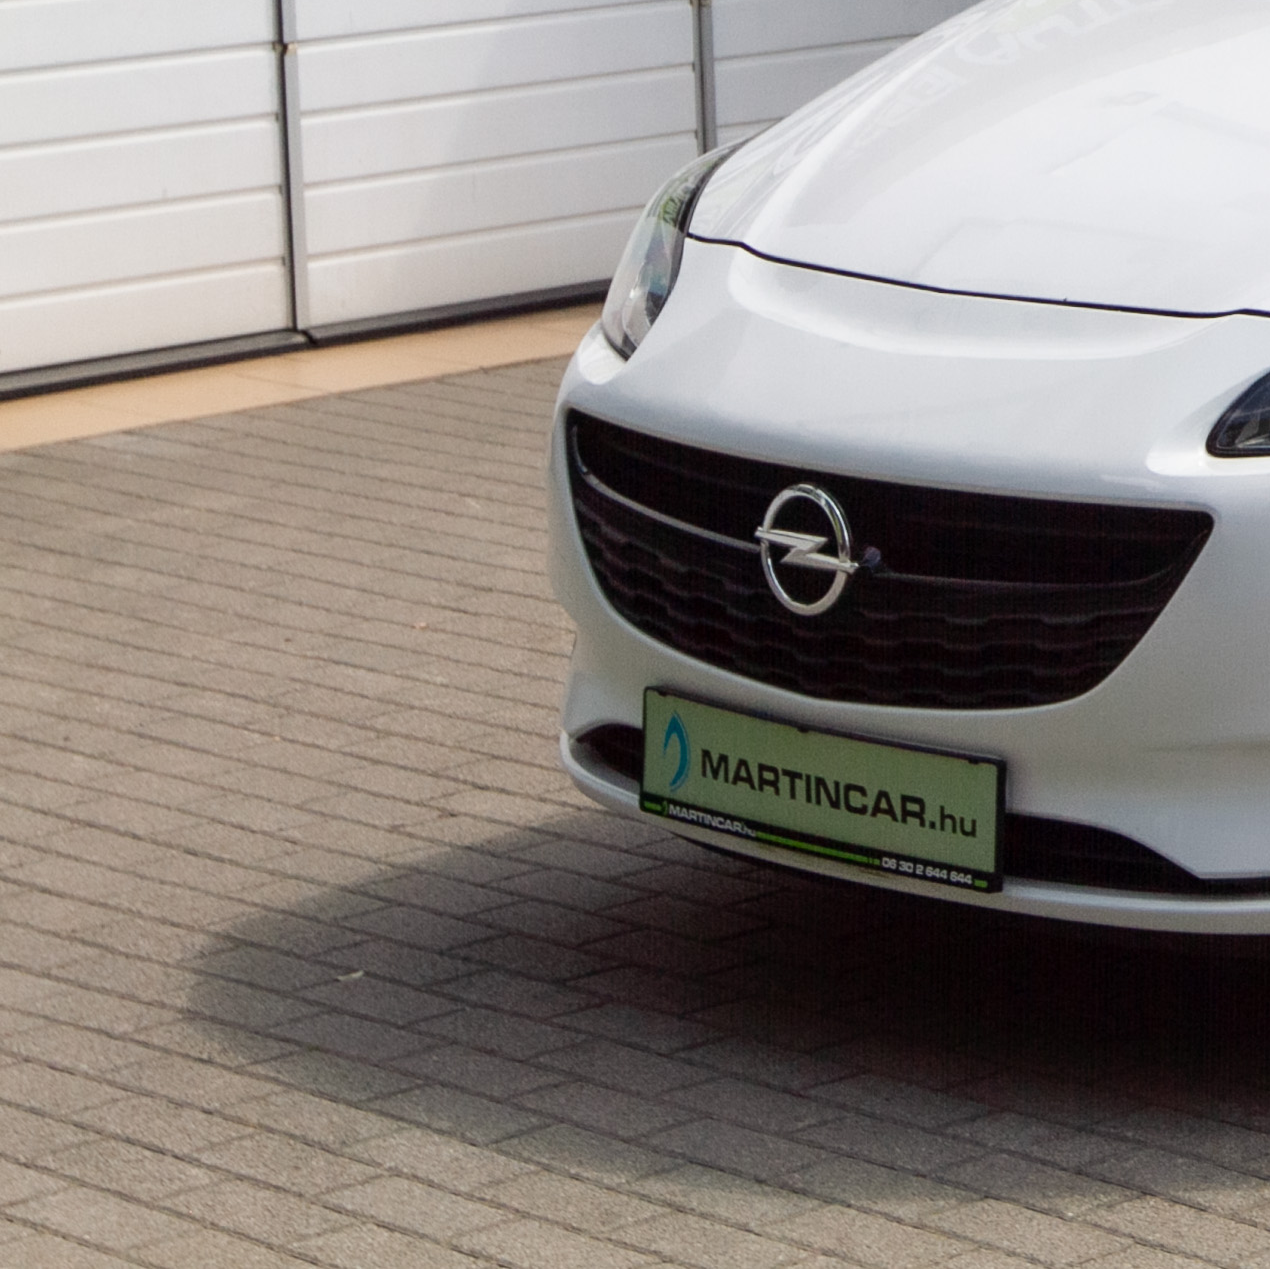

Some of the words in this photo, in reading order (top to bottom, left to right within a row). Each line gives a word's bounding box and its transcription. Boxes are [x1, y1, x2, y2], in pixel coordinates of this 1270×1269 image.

[700, 748, 978, 839] MARTINCAR.hu
[898, 860, 914, 873] 30
[915, 863, 924, 876] 2
